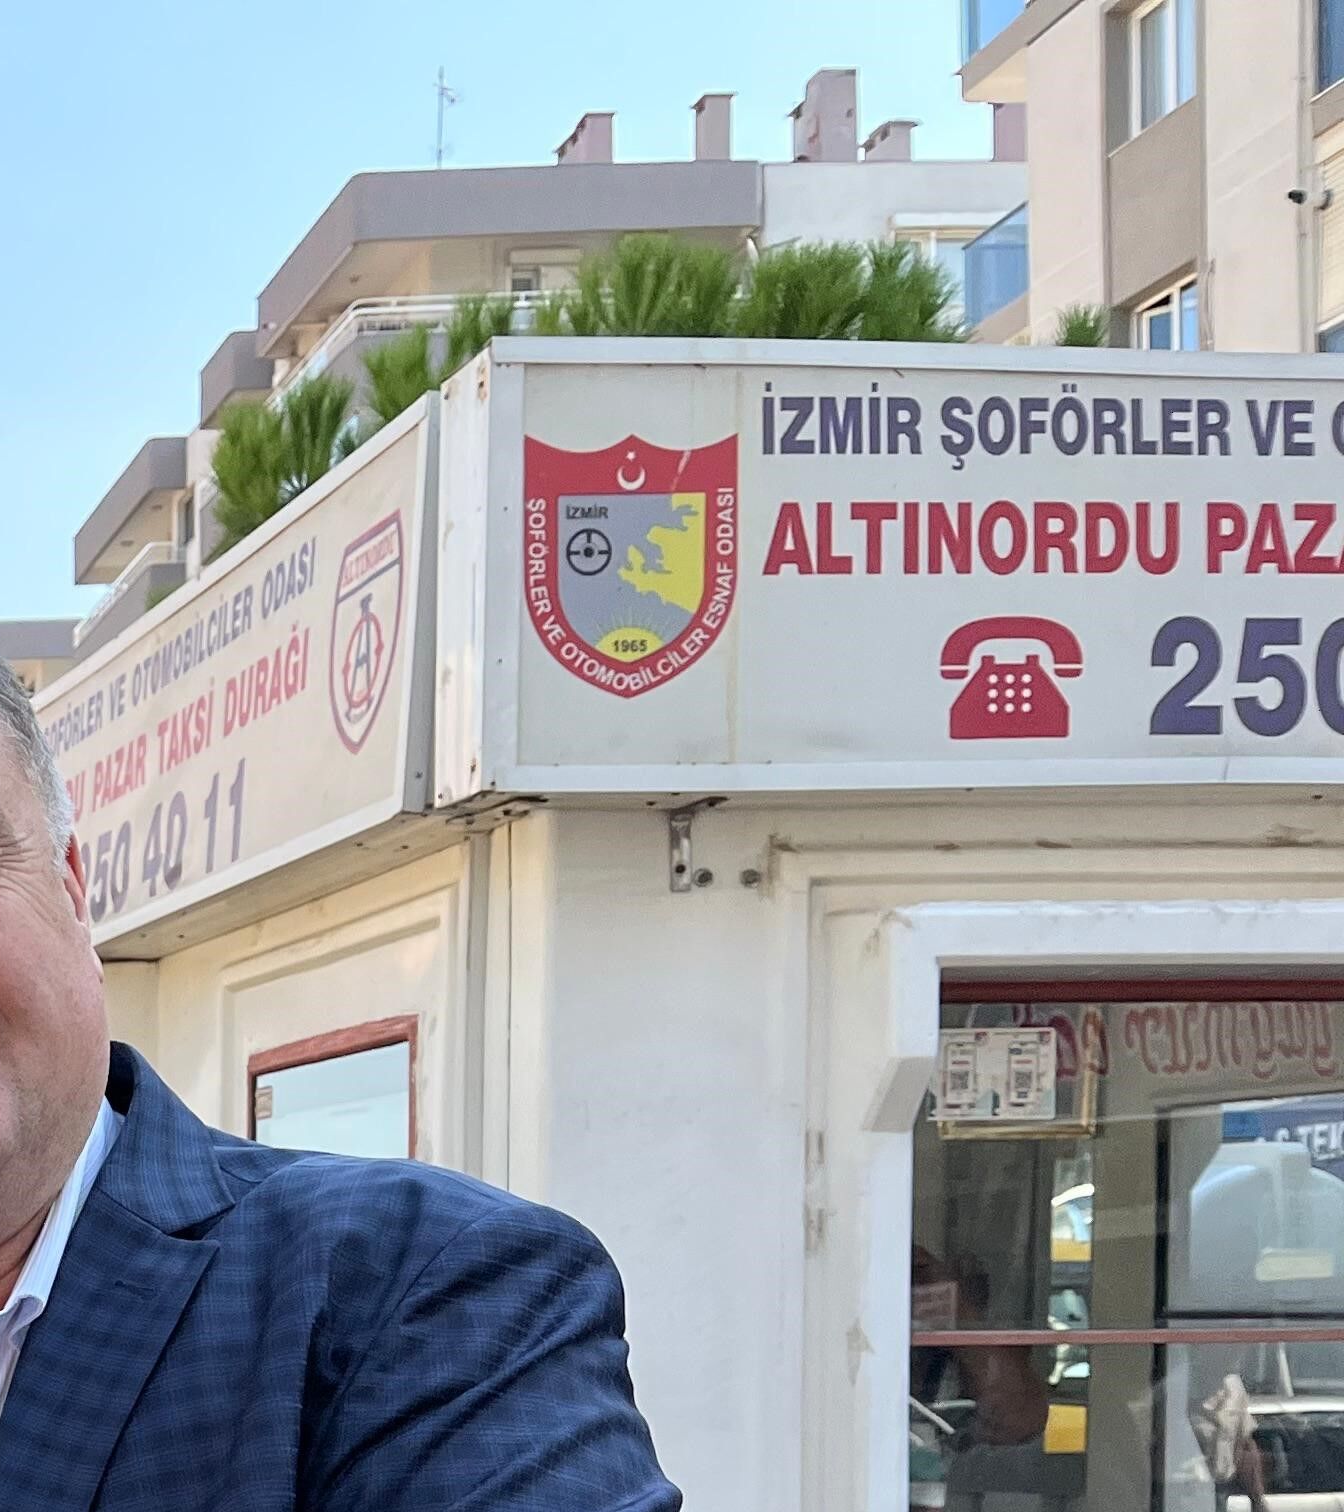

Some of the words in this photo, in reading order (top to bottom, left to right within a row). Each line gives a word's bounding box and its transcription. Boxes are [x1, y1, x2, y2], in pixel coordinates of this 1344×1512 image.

[762, 382, 922, 456] İZMİR
[940, 383, 1231, 471] ŞOFÖRLER
[1245, 399, 1316, 457] VE
[566, 504, 609, 519] İZMİR
[716, 487, 735, 556] ODASI
[762, 500, 1180, 576] ALTINORDU
[1206, 501, 1344, 576] PAZ
[527, 498, 553, 616] ŞOFÖRLER
[109, 672, 127, 721] VE
[132, 590, 254, 707] OTOMOBİLCİLER
[261, 536, 317, 620] ODASI
[542, 615, 567, 646] VE
[702, 561, 735, 629] ESNAF
[560, 628, 710, 691] OTOMOBİLCİLER
[613, 639, 648, 652] 1965
[92, 733, 148, 813] PAZAR
[157, 676, 215, 775] TAKSİ
[223, 620, 310, 738] DURAĞI
[142, 791, 188, 897] 40
[204, 757, 246, 875] 11
